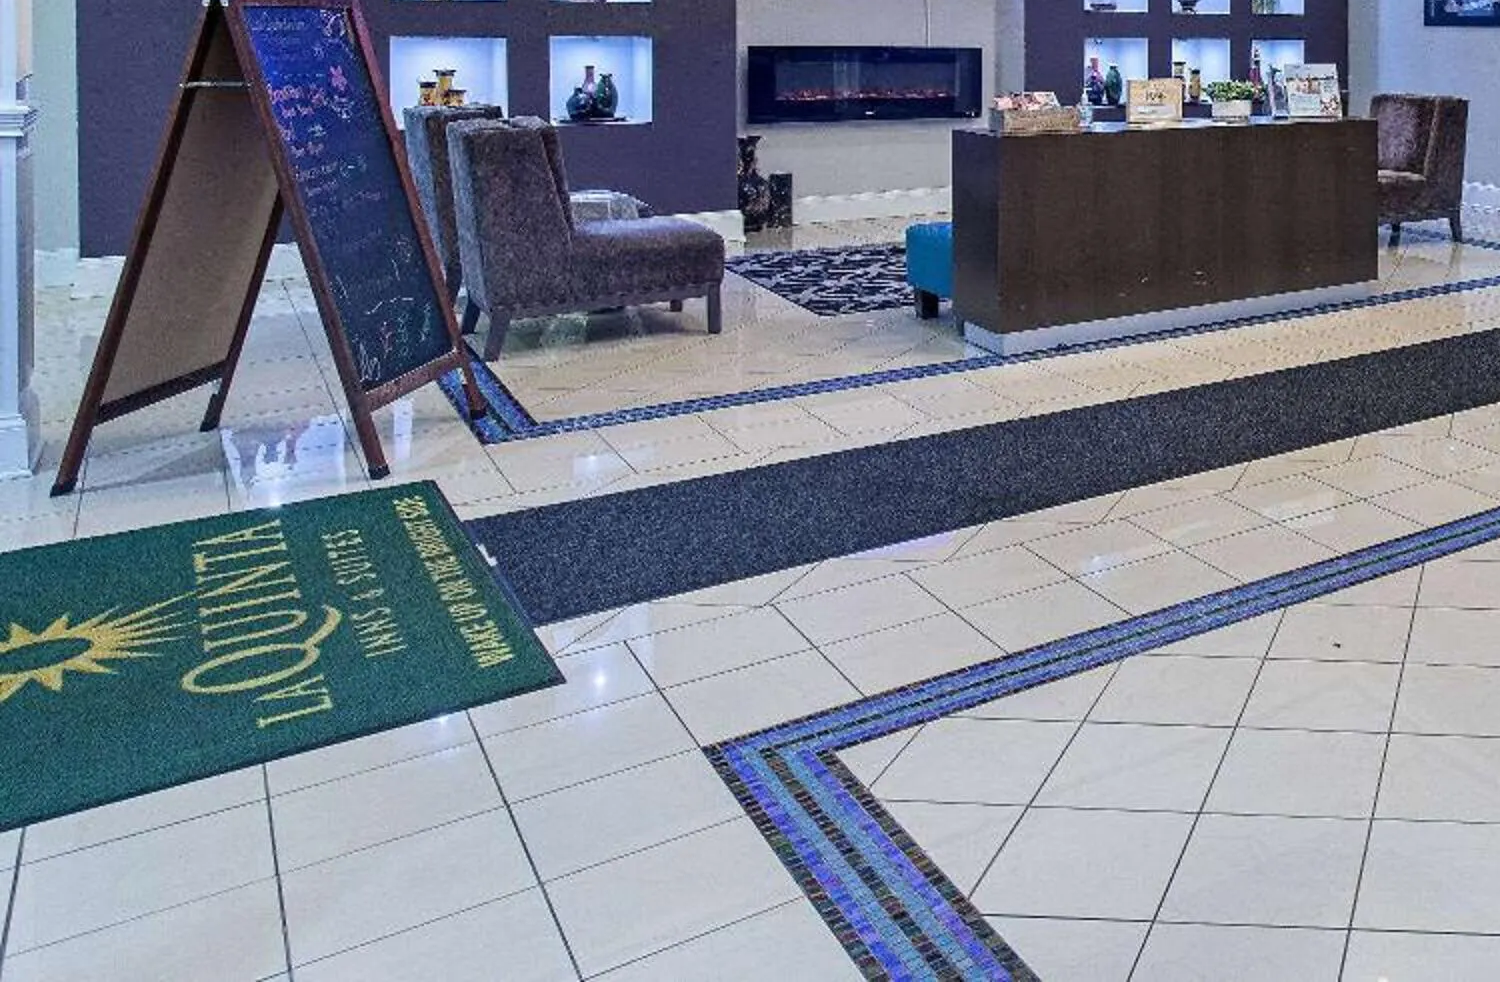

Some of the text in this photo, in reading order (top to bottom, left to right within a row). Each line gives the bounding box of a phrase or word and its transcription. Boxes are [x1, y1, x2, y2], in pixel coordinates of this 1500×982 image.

[321, 528, 378, 585] SUITES
[423, 555, 465, 583] THE
[436, 577, 478, 601] ON
[448, 602, 489, 623] UP
[181, 518, 343, 728] LA QUINTA
[351, 606, 409, 659] INNS
[459, 619, 515, 669] WAKE
